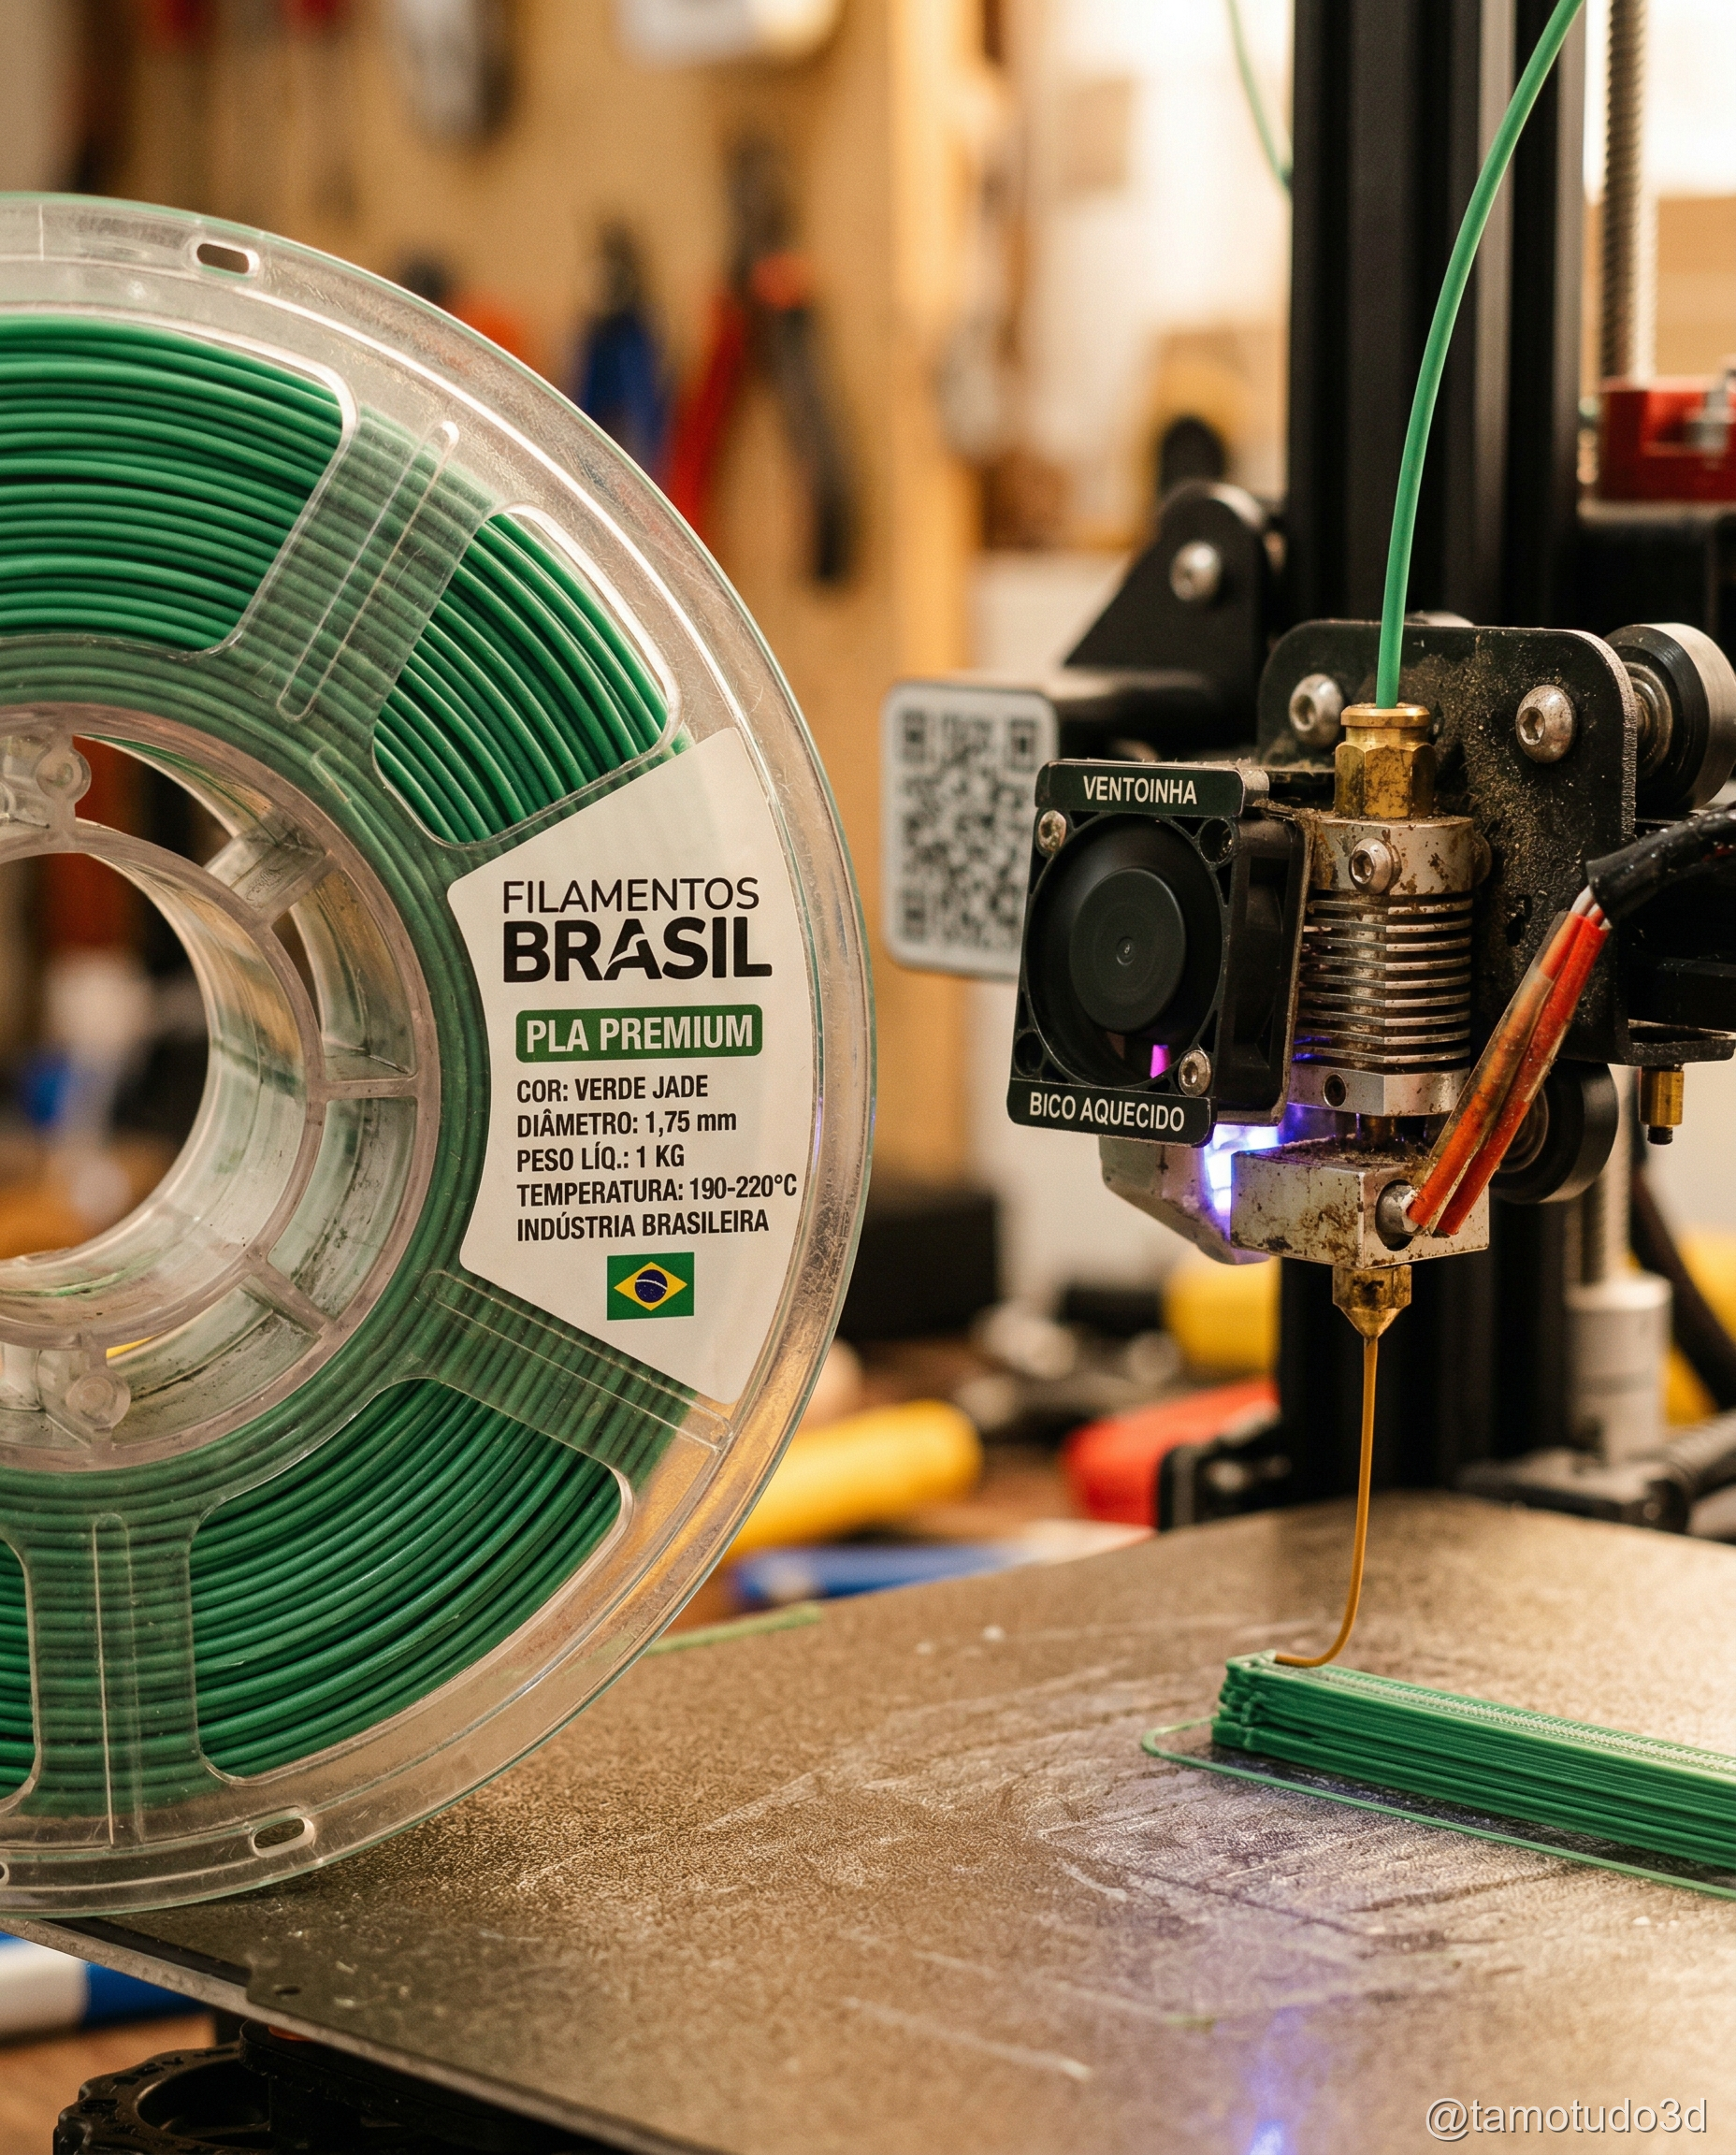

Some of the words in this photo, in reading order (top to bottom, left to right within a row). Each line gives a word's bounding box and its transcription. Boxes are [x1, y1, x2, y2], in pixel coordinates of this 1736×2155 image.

[1084, 776, 1196, 804] VENTOINHA
[504, 877, 759, 914] FILAMENTOS
[504, 917, 772, 982] BRASIL
[528, 1020, 588, 1052] PLA
[600, 1015, 752, 1050] PREMIUM
[517, 1079, 569, 1103] COR:
[575, 1077, 645, 1101] VERDE
[653, 1075, 708, 1098] JADE
[518, 1108, 638, 1137] DIÂMETRO:
[646, 1110, 689, 1137] 1,75
[698, 1113, 736, 1131] mm
[1030, 1092, 1076, 1120] BICO
[1080, 1096, 1185, 1132] AQUECIDO
[518, 1148, 573, 1172] PESO
[582, 1142, 629, 1170] LÍQ.:
[636, 1146, 646, 1168] 1
[657, 1144, 684, 1167] KG
[517, 1179, 683, 1207] TEMPERATURA:
[690, 1174, 796, 1199] 190-220°C
[518, 1212, 635, 1241] INDÚSTRIA
[643, 1209, 769, 1236] BRASILEIRA
